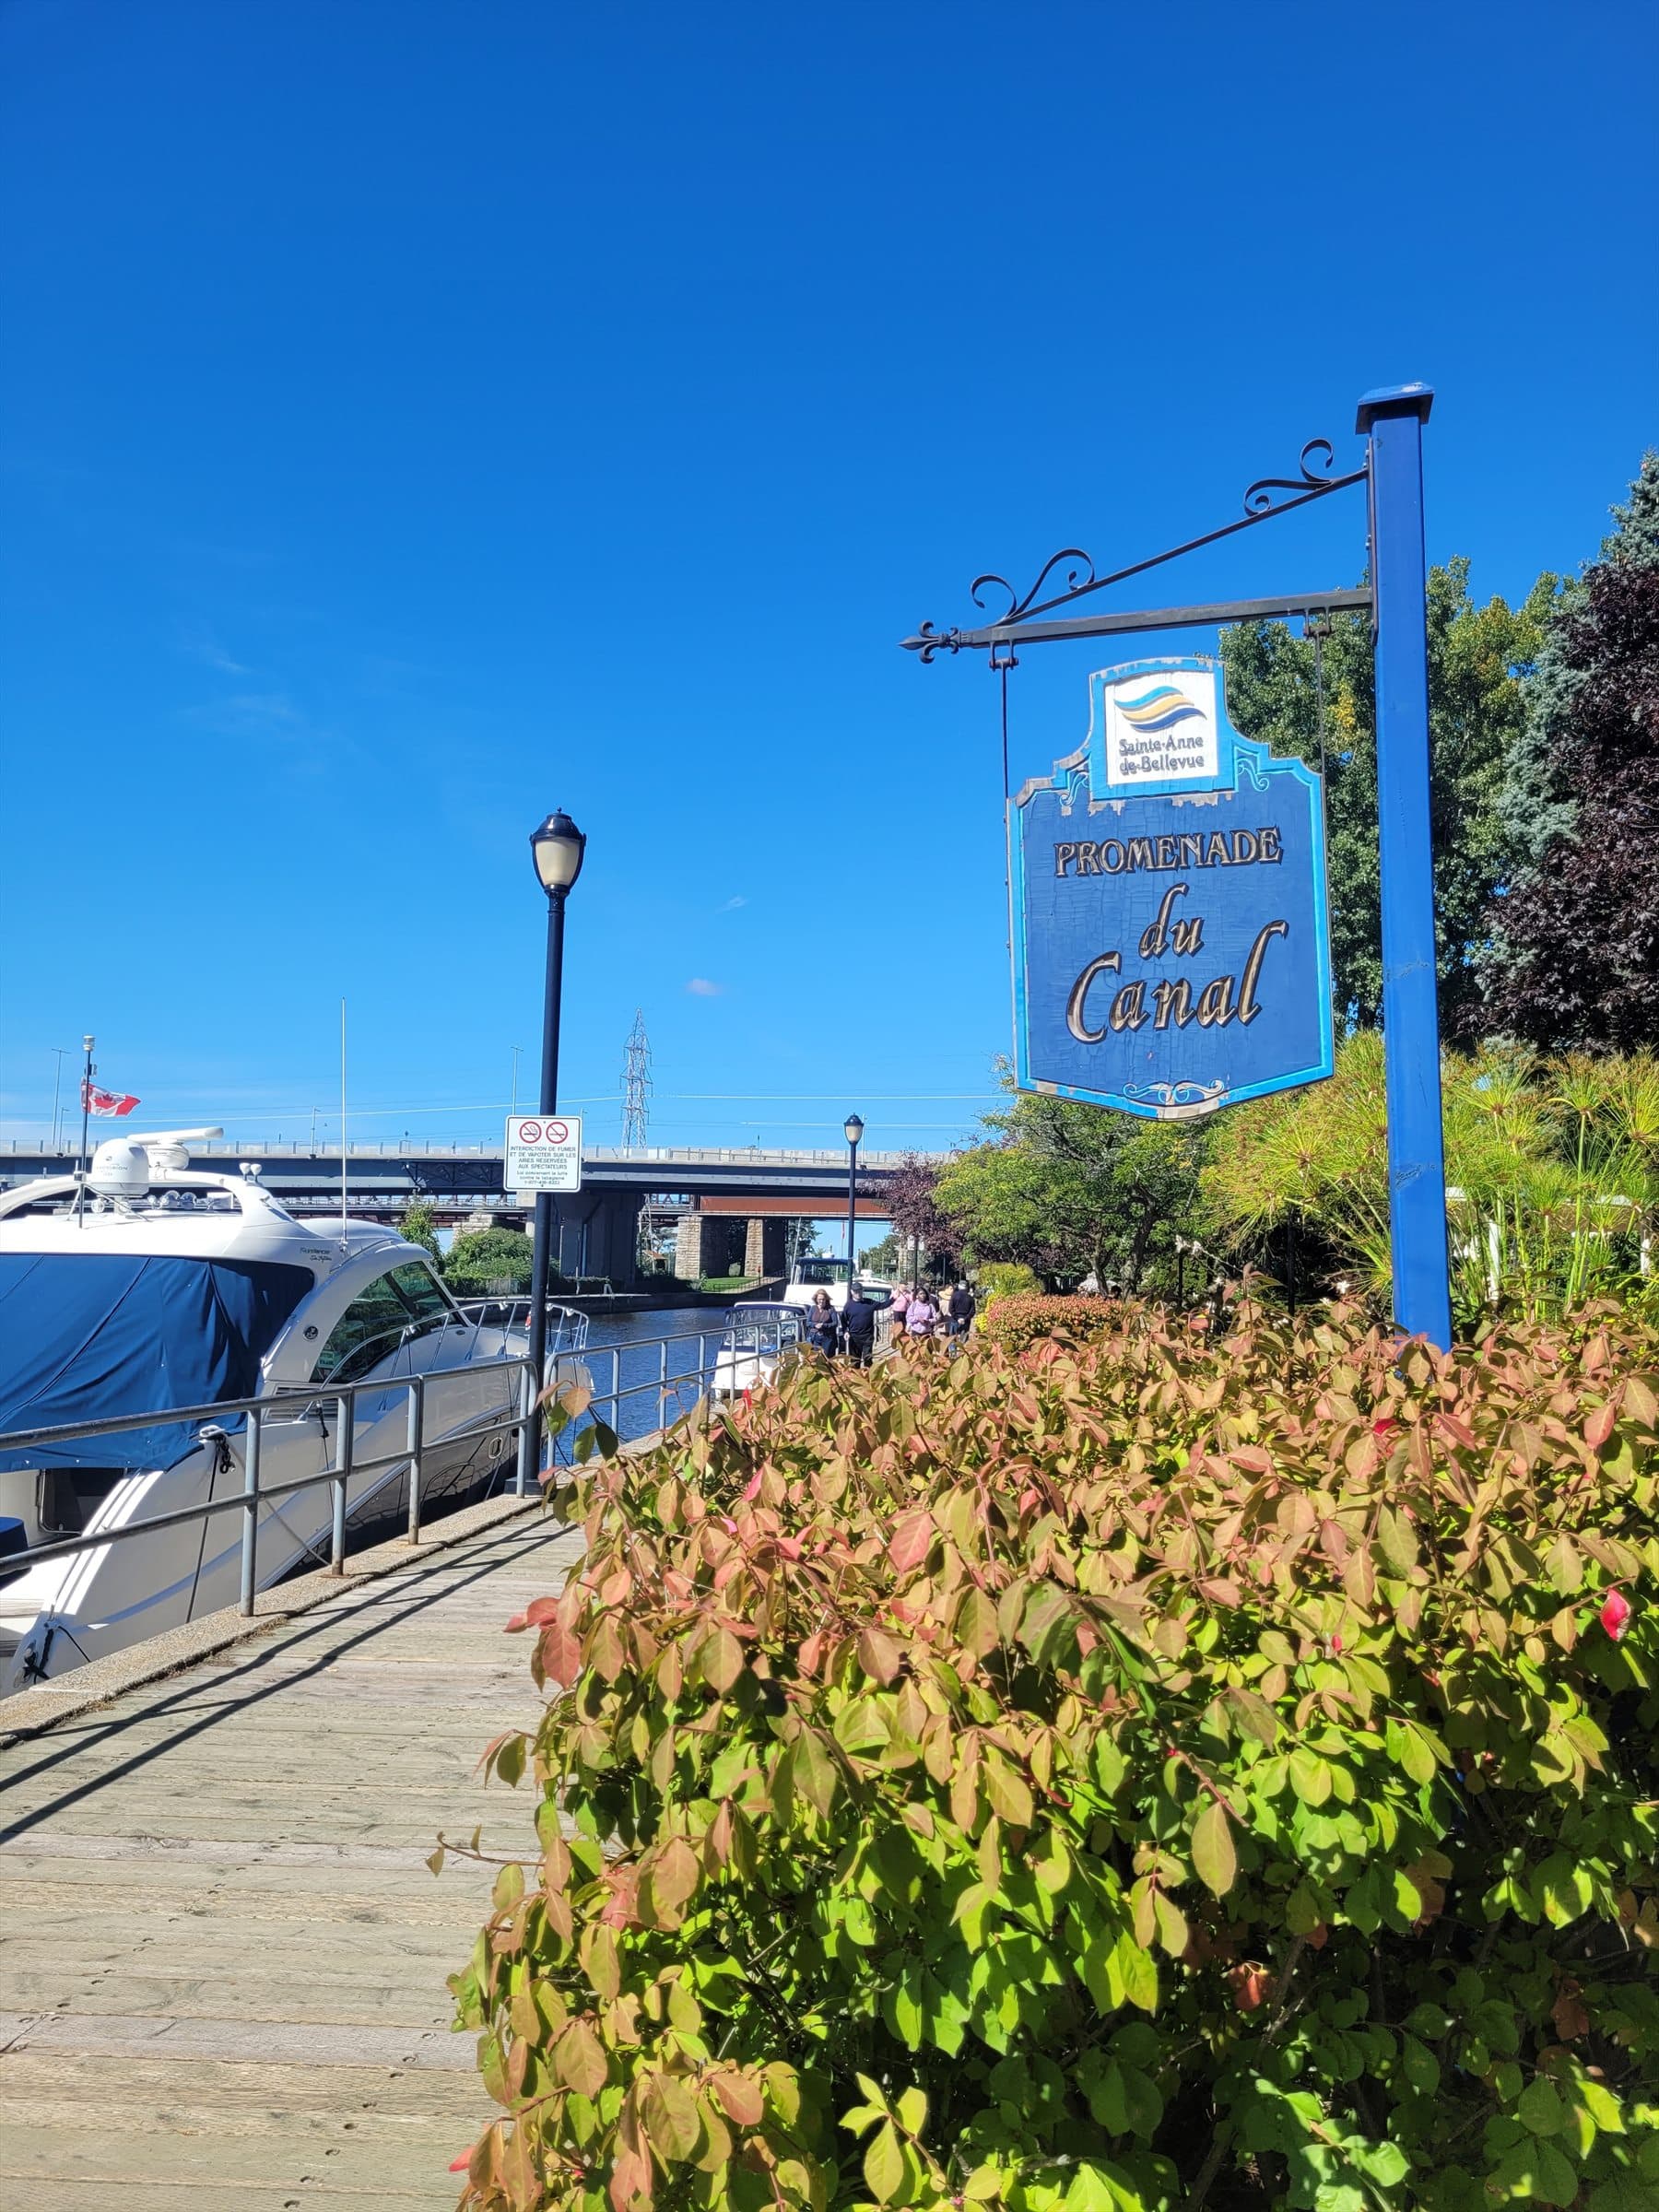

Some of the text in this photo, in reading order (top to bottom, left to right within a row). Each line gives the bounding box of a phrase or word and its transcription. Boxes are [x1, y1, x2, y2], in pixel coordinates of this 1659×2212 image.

[1119, 735, 1204, 757] Sainte-Anne
[1119, 754, 1205, 776] de-Bellevue
[1053, 826, 1283, 877] PROMENADE
[1138, 882, 1205, 961] du
[1065, 920, 1288, 1045] Canal
